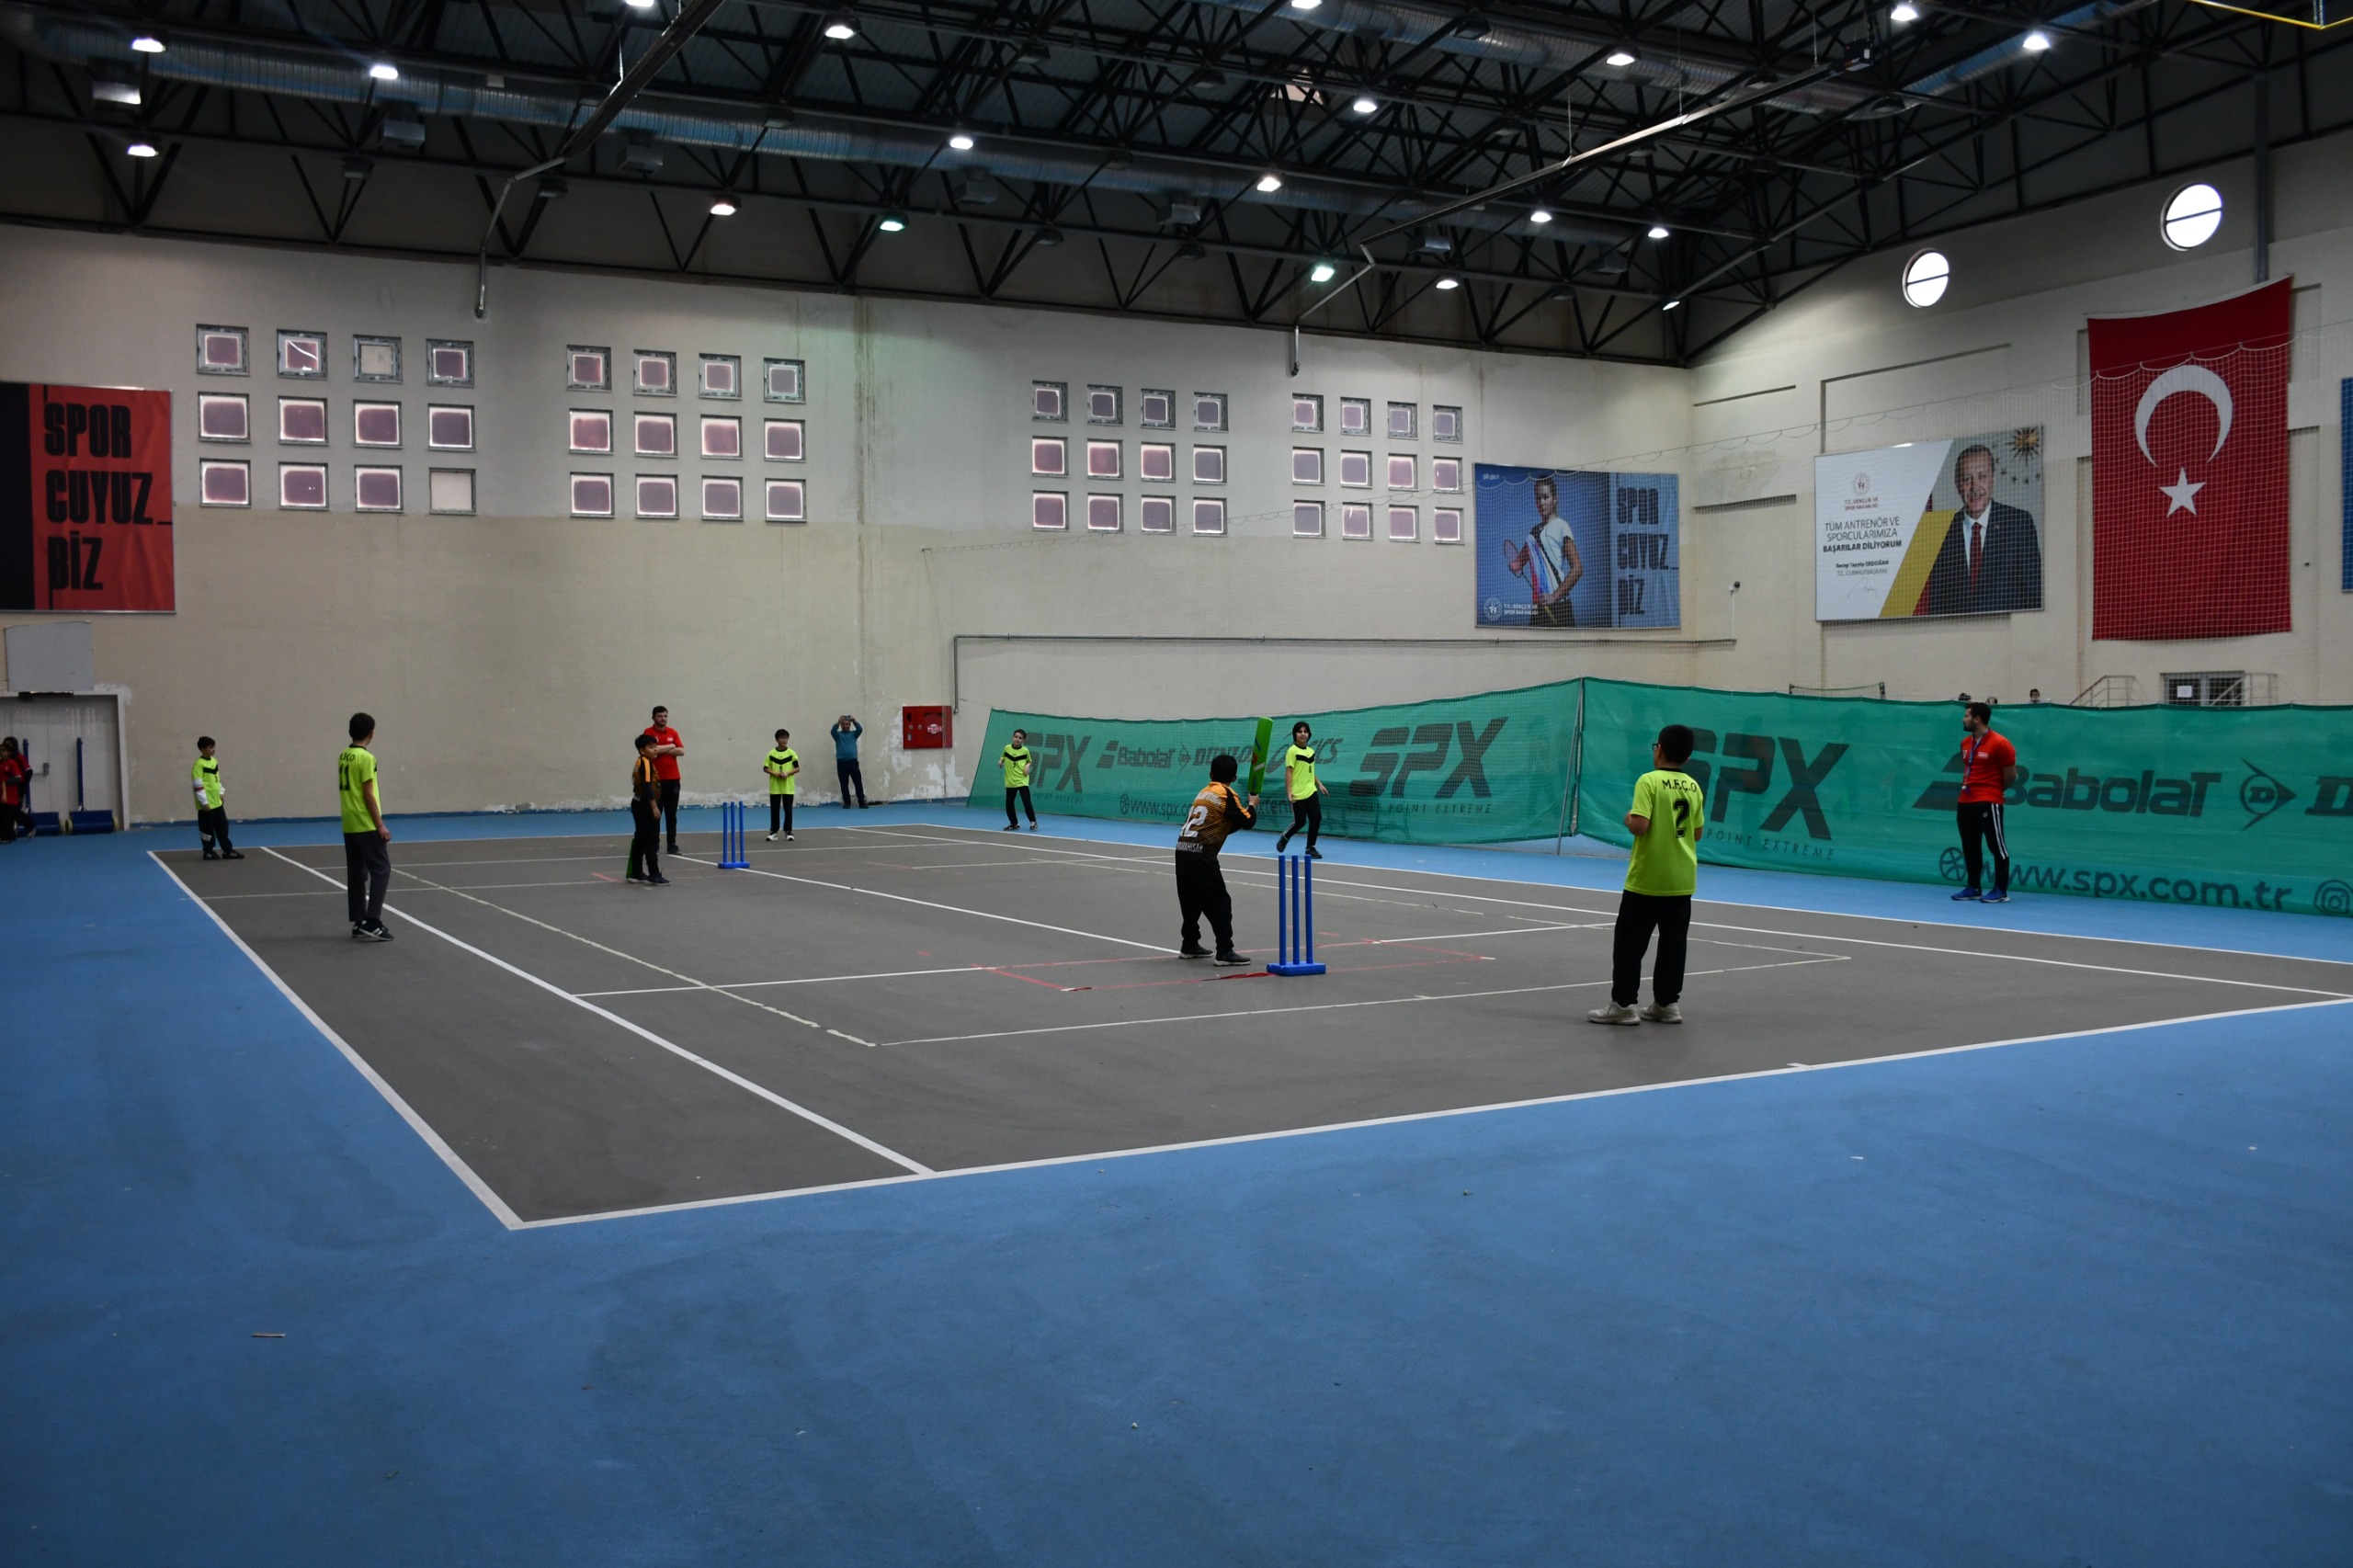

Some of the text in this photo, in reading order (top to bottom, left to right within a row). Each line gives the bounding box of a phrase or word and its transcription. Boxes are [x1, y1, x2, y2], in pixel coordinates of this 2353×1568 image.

[44, 403, 132, 459] SPOR
[1617, 486, 1659, 525] SPOR
[1824, 517, 1900, 531] TÜM ANTRENÖR VE
[1823, 540, 1903, 553] BAŞARILAR DİLİYORUM
[1827, 528, 1898, 542] SPORCULARIMIZA
[48, 530, 103, 590] BİZ
[1618, 574, 1645, 615] BİZ
[1349, 717, 1509, 799] SPX
[1706, 828, 1836, 861] POINT EXTREME
